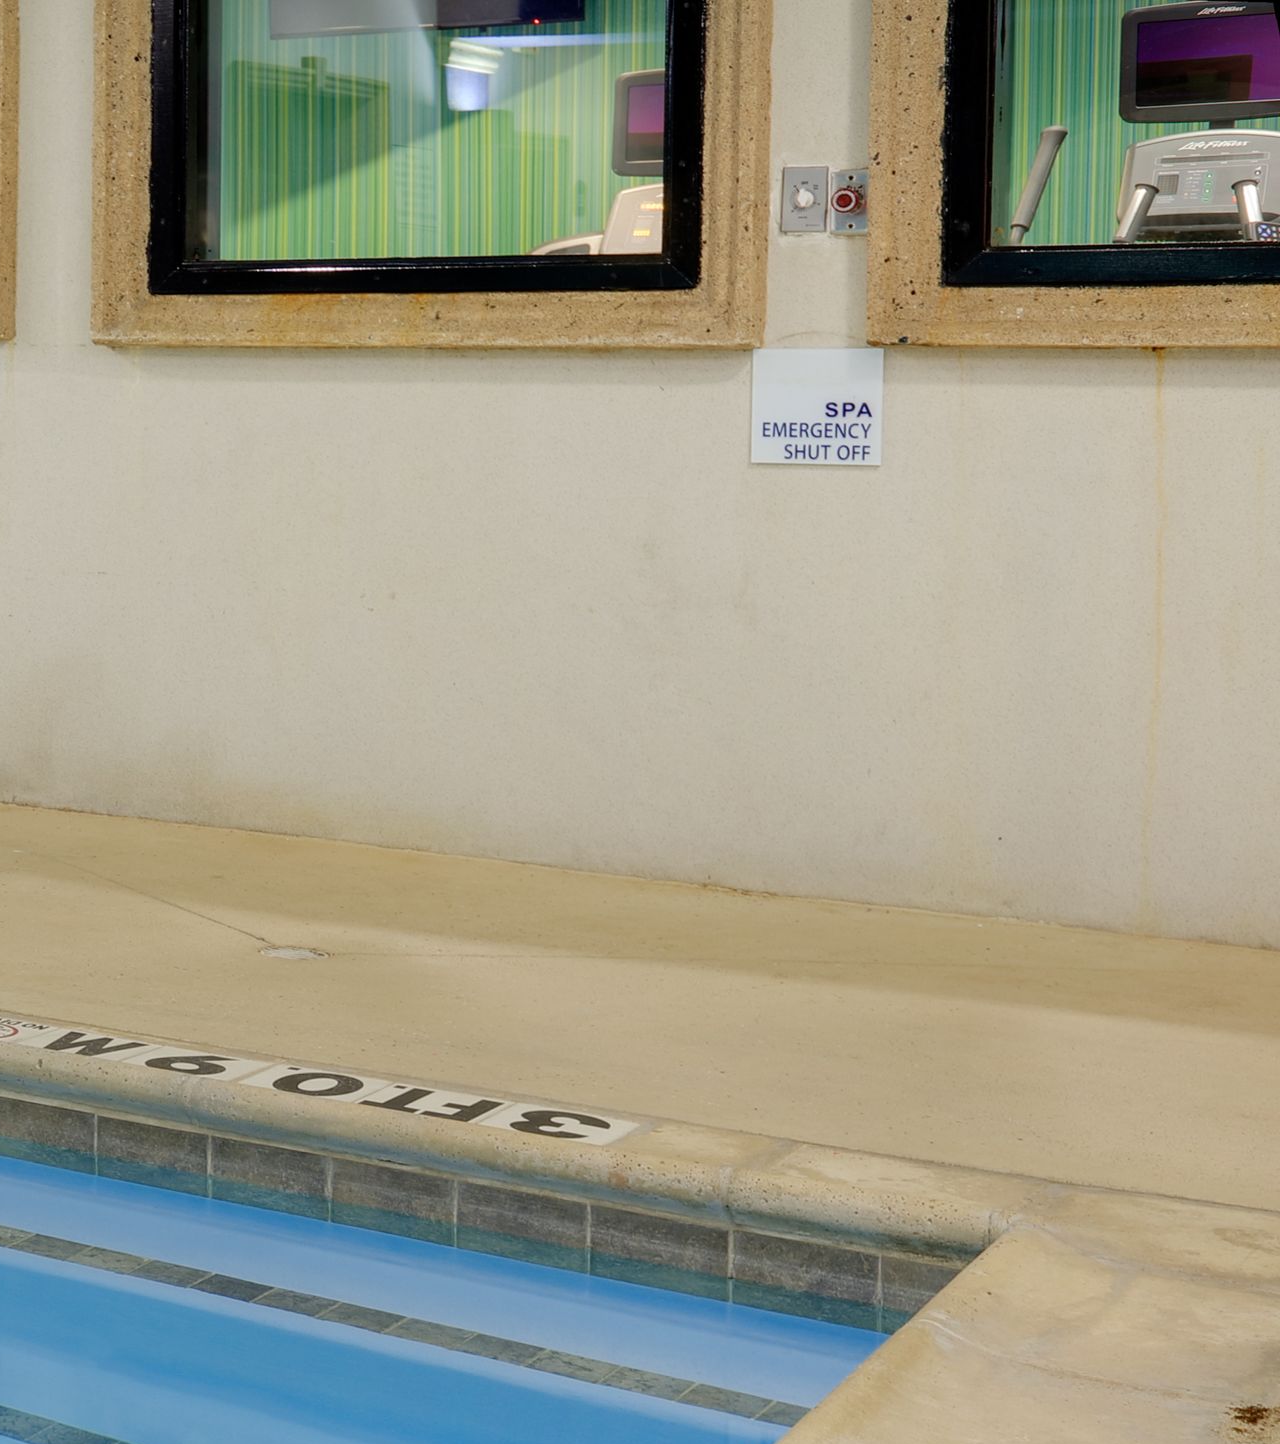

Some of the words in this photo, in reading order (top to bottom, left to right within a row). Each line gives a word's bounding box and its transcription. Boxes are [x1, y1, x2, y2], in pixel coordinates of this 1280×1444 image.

[825, 402, 873, 418] SPA
[762, 421, 872, 439] EMERGENCY
[784, 443, 832, 460] SHUT
[836, 444, 871, 461] OFF
[21, 1022, 49, 1031] NO
